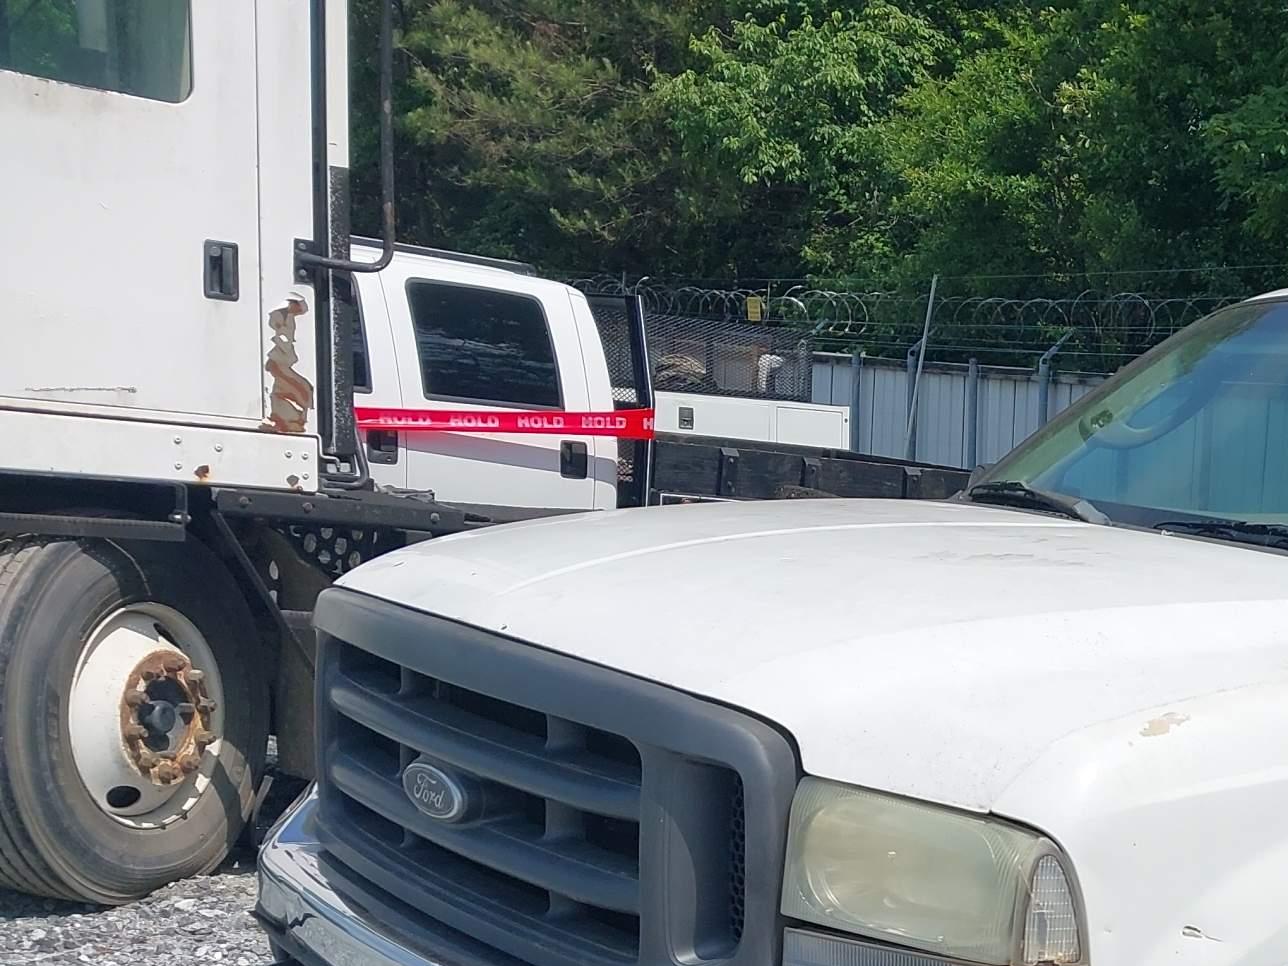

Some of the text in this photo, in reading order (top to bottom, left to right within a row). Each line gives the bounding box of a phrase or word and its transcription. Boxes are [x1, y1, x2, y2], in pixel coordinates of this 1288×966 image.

[449, 416, 499, 427] HOLD
[517, 416, 564, 428] HOLD
[581, 417, 627, 429] HOLD
[413, 773, 445, 808] Ford
